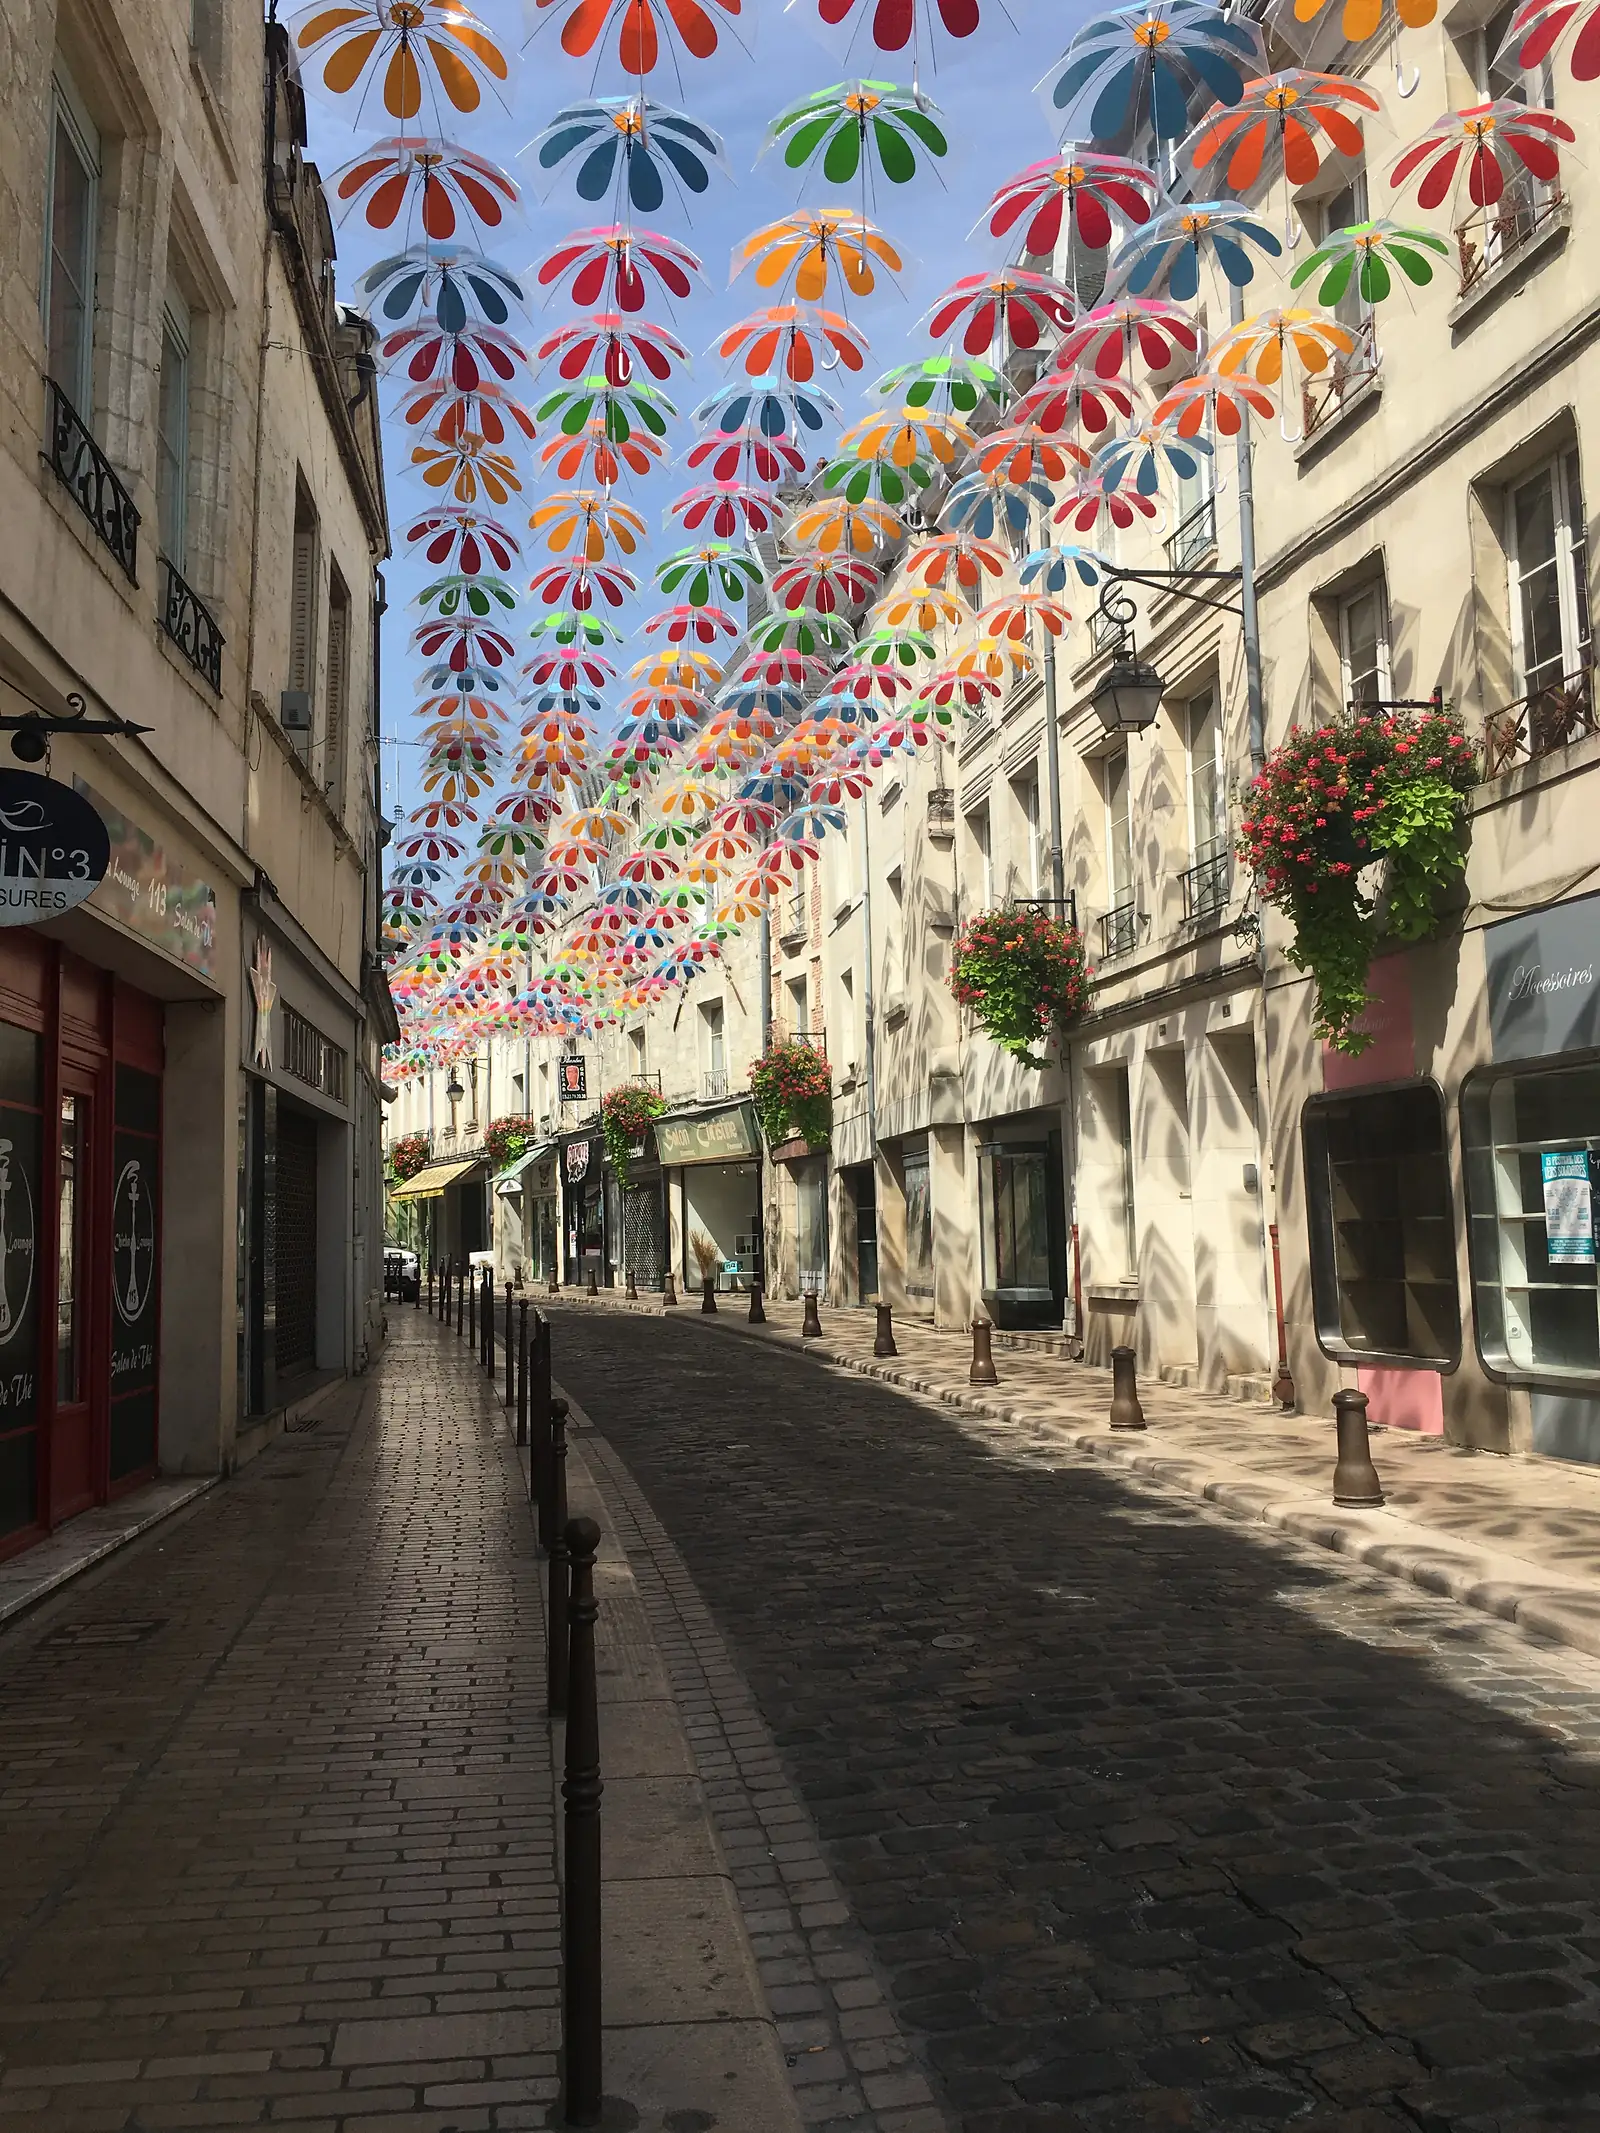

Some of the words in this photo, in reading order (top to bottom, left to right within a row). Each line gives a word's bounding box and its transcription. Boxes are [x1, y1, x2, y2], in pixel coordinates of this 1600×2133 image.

[113, 857, 140, 902] Lounge
[148, 878, 167, 917] 113
[1508, 963, 1593, 1000] Accessoires
[663, 1127, 690, 1152] Salon
[696, 1117, 738, 1148] Christine
[8, 1231, 33, 1256] Lounge
[111, 1351, 130, 1377] Salon
[11, 1373, 33, 1407] Thé
